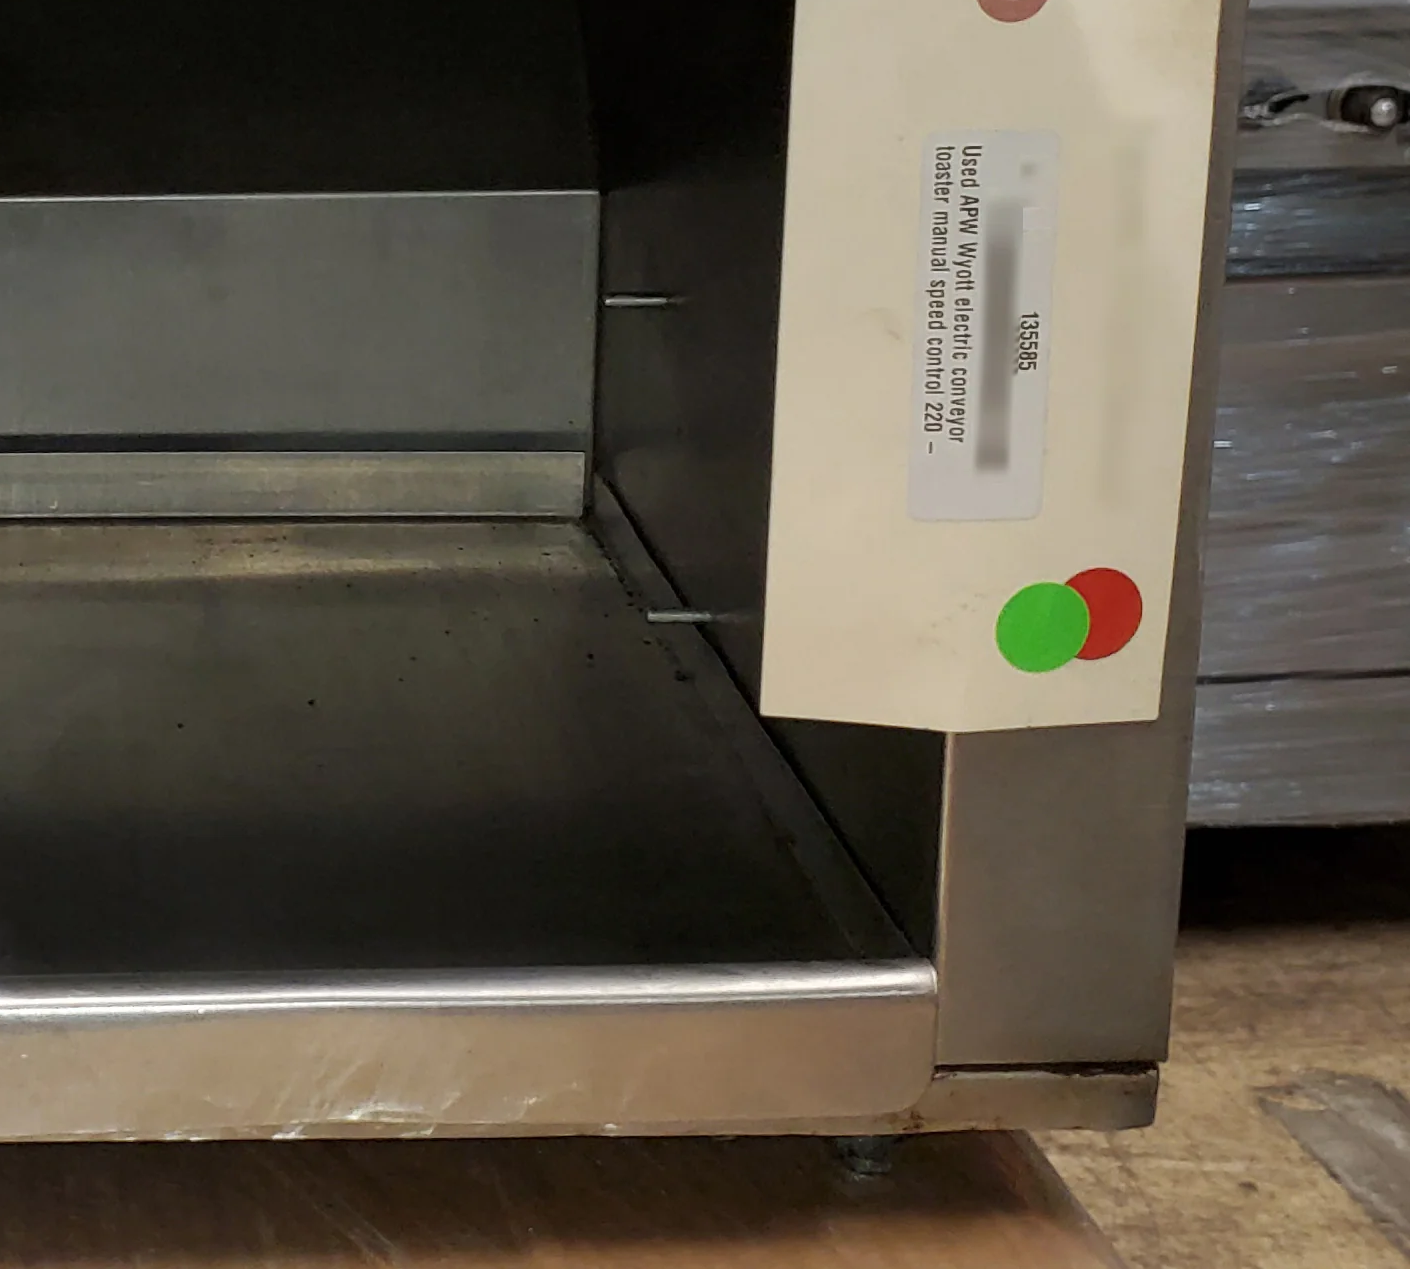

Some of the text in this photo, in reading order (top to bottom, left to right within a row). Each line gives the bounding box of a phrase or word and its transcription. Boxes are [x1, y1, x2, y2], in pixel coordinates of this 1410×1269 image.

[933, 145, 956, 204] toaster
[930, 211, 950, 272] manual
[925, 279, 948, 330] speed
[945, 145, 982, 443] Used APW Wyott electric conveyor
[924, 337, 945, 394] control
[1018, 312, 1039, 371] 135585
[923, 402, 943, 433] 220
